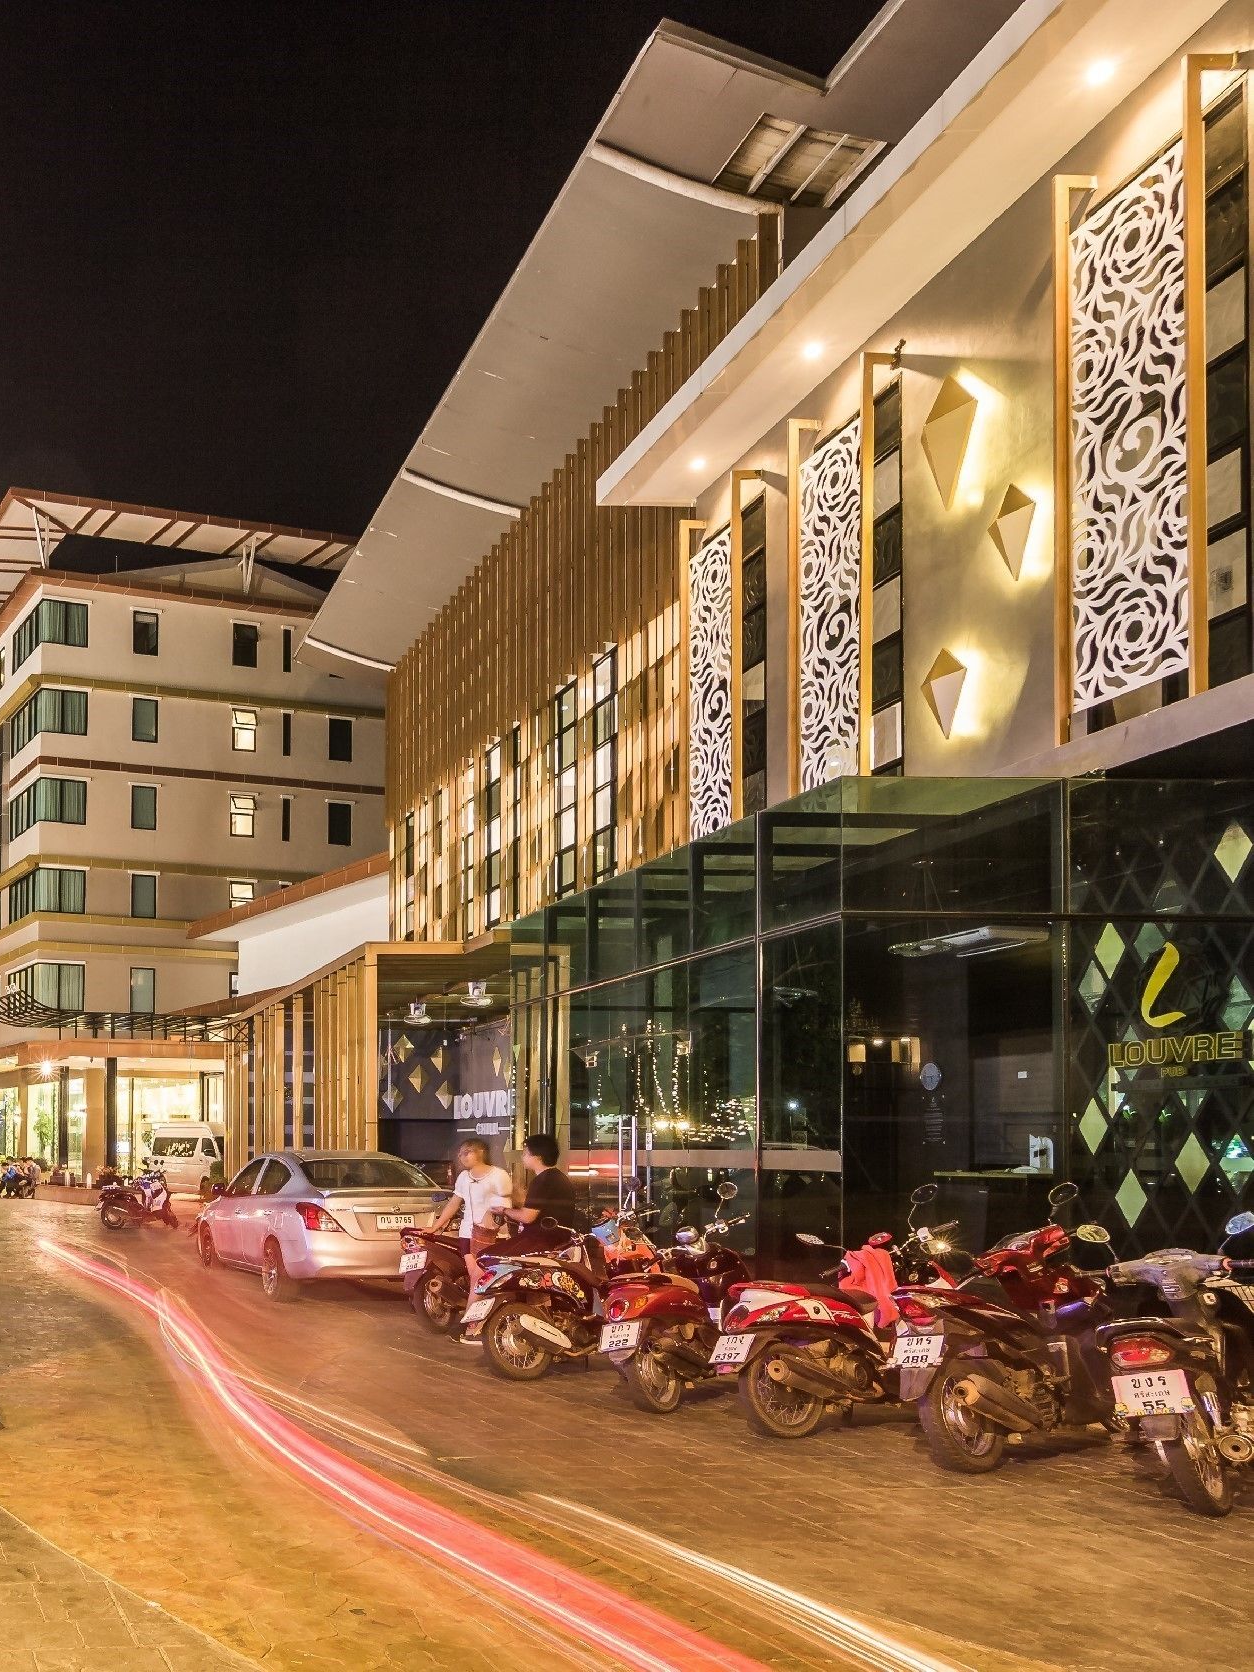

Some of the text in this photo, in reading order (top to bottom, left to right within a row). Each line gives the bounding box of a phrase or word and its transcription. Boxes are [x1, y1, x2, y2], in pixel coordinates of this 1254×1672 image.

[1108, 1031, 1240, 1068] LOUVRE
[1160, 1066, 1187, 1078] PUB
[608, 1339, 629, 1348] 222
[714, 1352, 741, 1361] 6397
[901, 1355, 929, 1364] 488
[1141, 1399, 1167, 1411] 55
